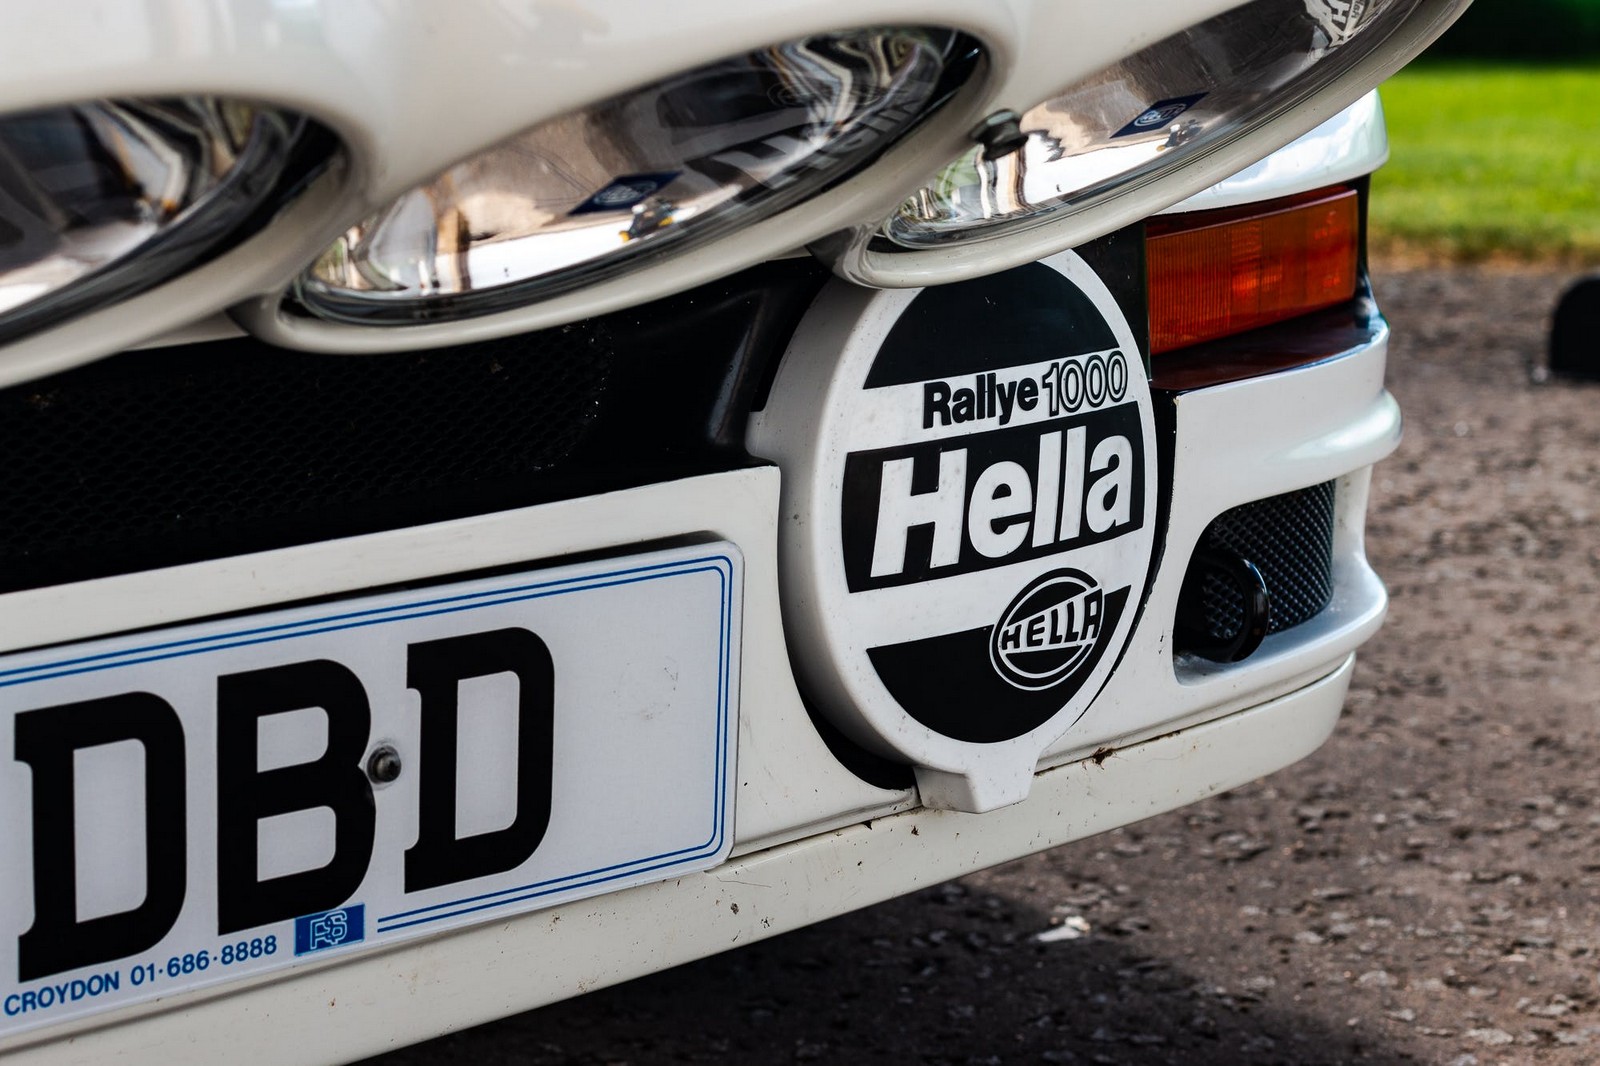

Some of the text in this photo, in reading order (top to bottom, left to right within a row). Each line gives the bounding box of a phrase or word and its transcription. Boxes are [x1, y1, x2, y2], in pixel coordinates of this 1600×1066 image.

[923, 350, 1128, 429] Rallye 1000
[870, 425, 1133, 577] Hella
[1002, 588, 1102, 650] HELLA
[14, 626, 555, 983] DBD
[4, 971, 120, 1016] CROYDON
